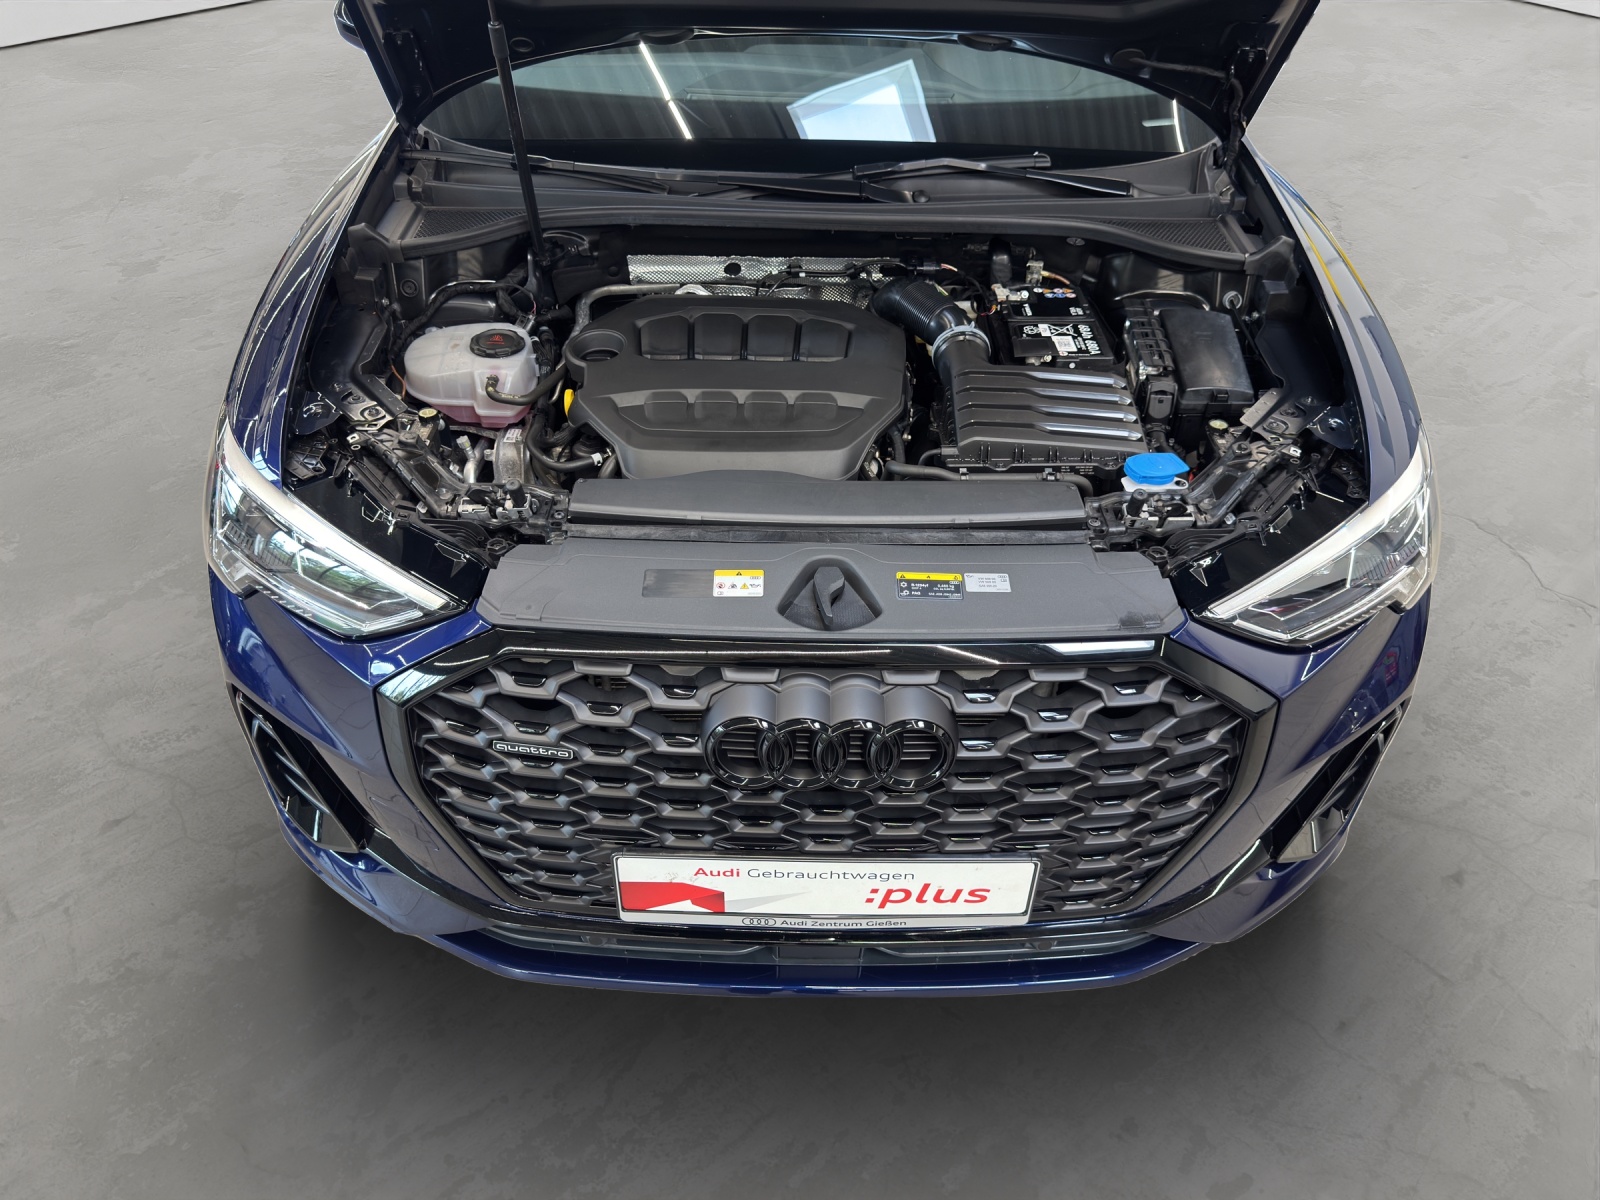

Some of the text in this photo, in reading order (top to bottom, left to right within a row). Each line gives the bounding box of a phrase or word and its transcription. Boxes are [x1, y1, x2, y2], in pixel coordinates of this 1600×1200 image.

[496, 743, 569, 758] quattro
[694, 867, 915, 882] Audi Gebrauchtwagen
[865, 883, 991, 909] :plus
[780, 919, 808, 927] Audi
